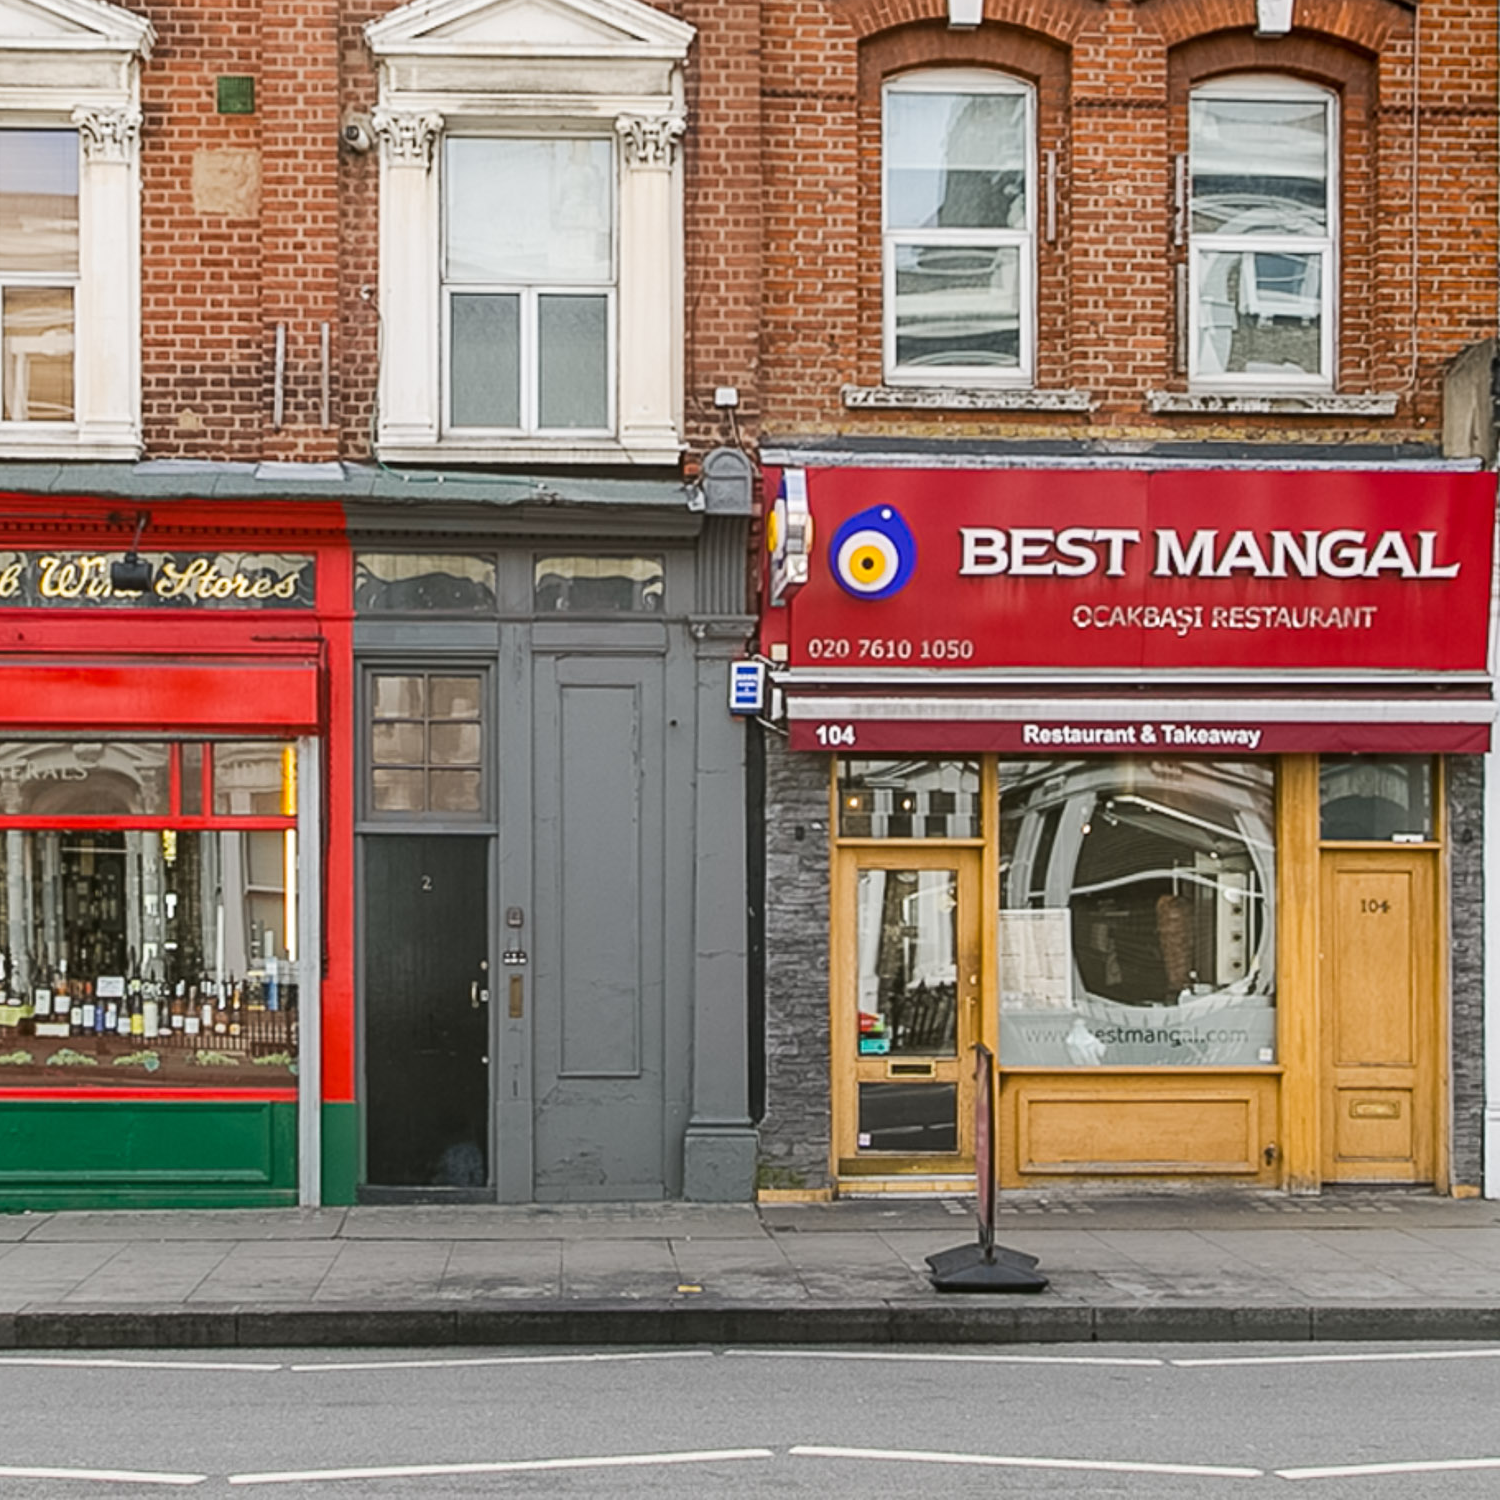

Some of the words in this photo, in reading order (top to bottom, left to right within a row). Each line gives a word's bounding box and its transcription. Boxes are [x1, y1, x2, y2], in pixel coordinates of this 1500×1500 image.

[959, 527, 1141, 576] BEST
[1153, 528, 1461, 578] MANGAL
[154, 558, 299, 598] Stores
[1211, 605, 1378, 629] RESTAURANT
[808, 639, 850, 659] 020
[858, 639, 912, 659] 7610
[920, 639, 973, 660] 1050
[815, 724, 856, 746] 104
[1022, 724, 1136, 744] Restaurant
[1140, 724, 1157, 744] &
[1161, 724, 1262, 749] Takeaway
[421, 875, 432, 890] 2
[1361, 899, 1391, 914] 104
